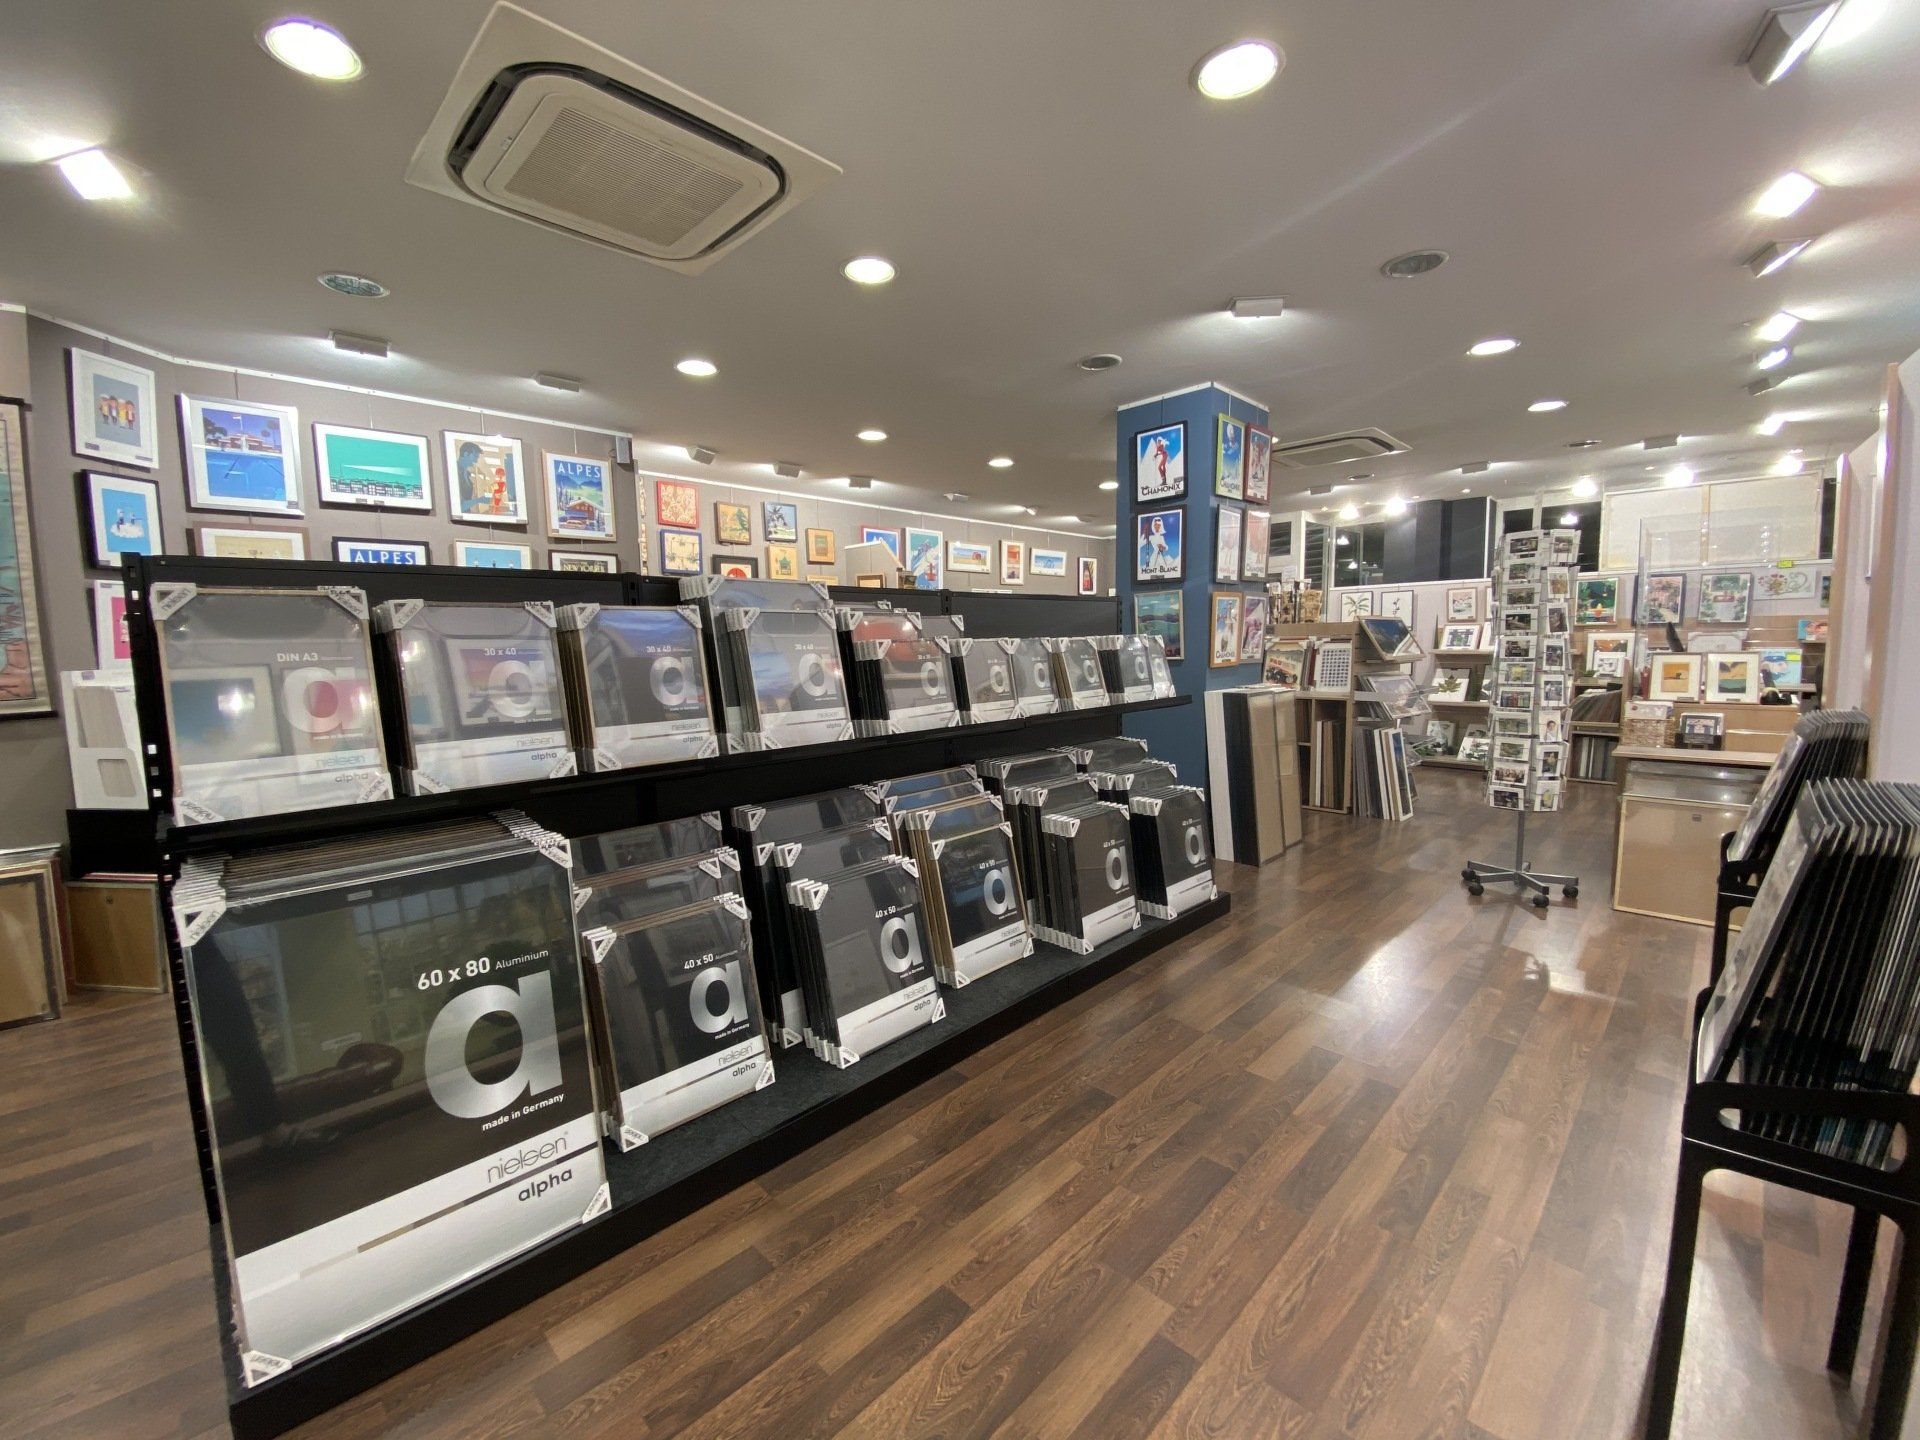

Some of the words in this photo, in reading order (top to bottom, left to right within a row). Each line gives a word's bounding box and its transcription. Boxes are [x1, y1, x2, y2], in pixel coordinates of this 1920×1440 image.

[558, 464, 600, 478] ALPES
[1141, 483, 1181, 496] CHAMONIX
[354, 550, 413, 565] ALPES
[276, 652, 299, 662] DIN
[302, 652, 318, 661] A3
[484, 647, 496, 656] 30
[505, 647, 517, 656] 40
[488, 660, 552, 718] a
[650, 656, 698, 705] a
[799, 653, 837, 696] a
[531, 752, 558, 761] alpha
[1184, 824, 1206, 865] a
[1105, 845, 1130, 890] a
[983, 865, 1017, 915] a
[875, 909, 883, 919] 40
[888, 905, 896, 914] 50
[880, 911, 924, 973] a
[417, 969, 443, 990] 60
[448, 967, 461, 982] x
[465, 957, 490, 977] 80
[495, 950, 549, 970] Aluminium
[684, 959, 694, 970] 40
[696, 958, 702, 966] x
[702, 953, 714, 964] 50
[689, 960, 748, 1034] a
[913, 999, 931, 1012] alpha
[424, 969, 563, 1119] a
[718, 1043, 753, 1067] nielsen
[732, 1061, 757, 1078] alpha
[482, 1116, 509, 1131] made
[511, 1110, 521, 1120] in
[522, 1093, 565, 1115] Germany
[487, 1136, 567, 1183] nielsen
[518, 1168, 572, 1202] alpha
